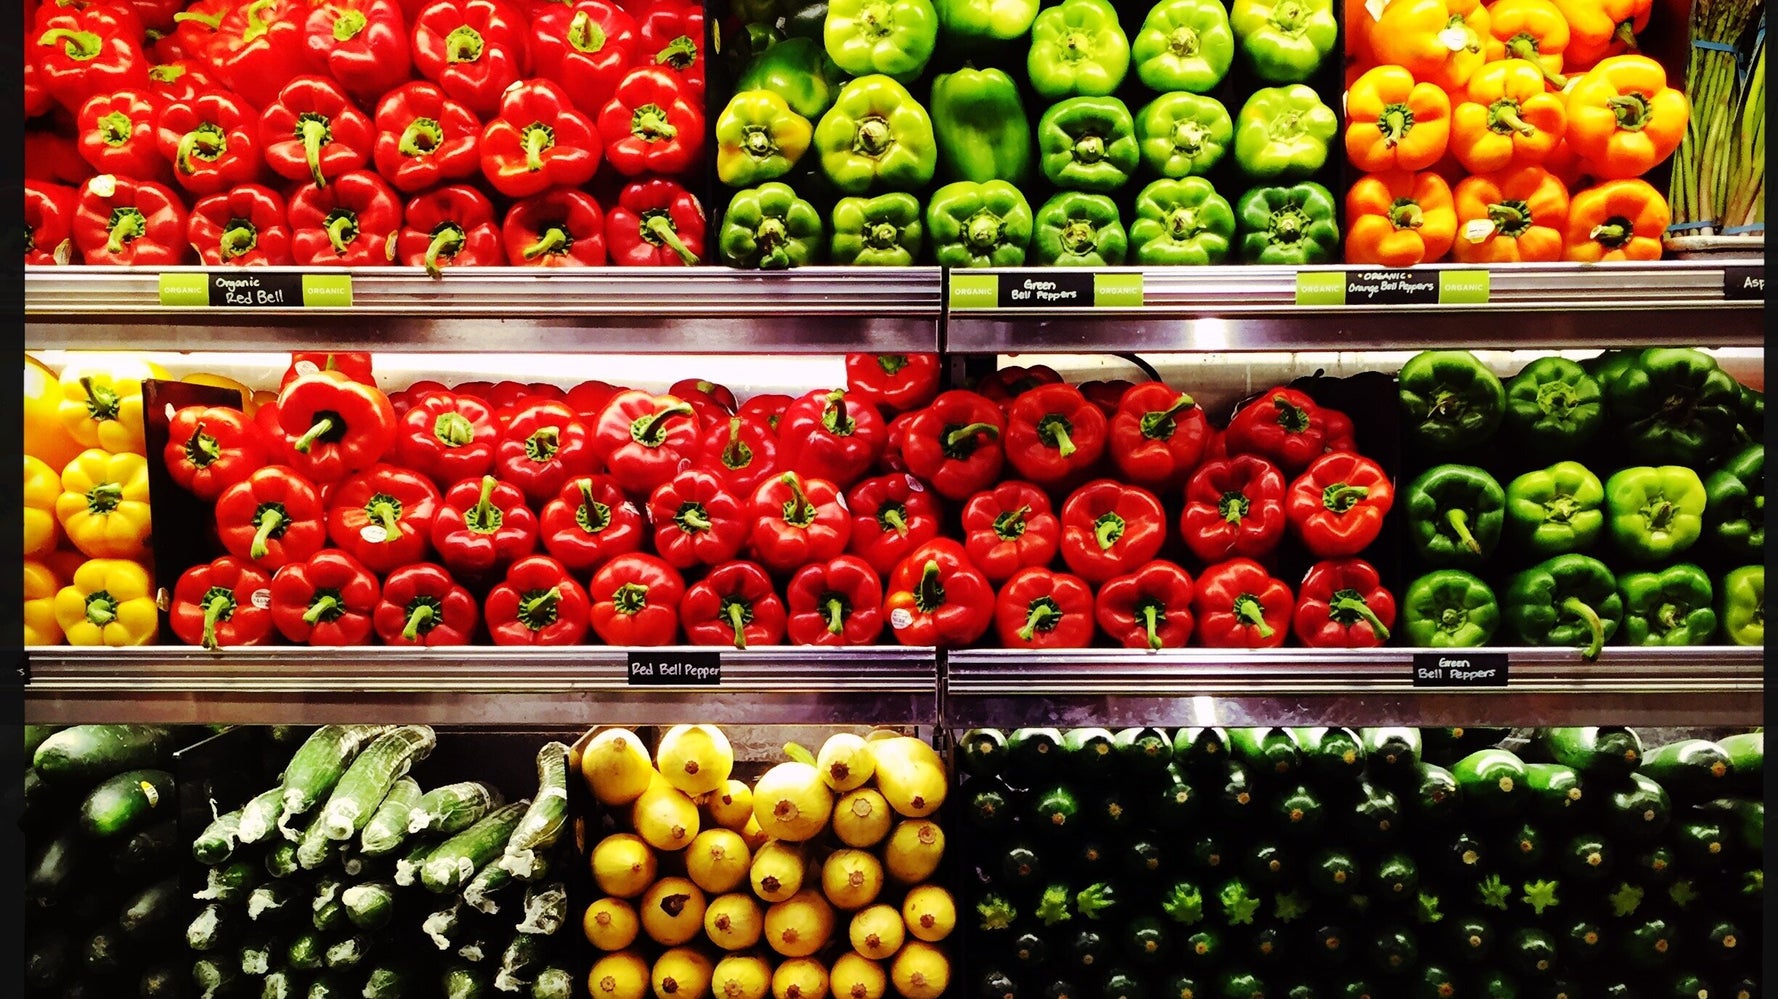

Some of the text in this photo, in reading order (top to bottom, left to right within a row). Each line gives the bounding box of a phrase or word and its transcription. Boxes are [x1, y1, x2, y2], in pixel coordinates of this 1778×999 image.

[1363, 272, 1407, 281] ORGANIC
[215, 276, 260, 292] Organic
[1023, 279, 1057, 291] Green
[1301, 285, 1340, 293] ORGANIC
[1444, 284, 1483, 292] ORGANIC
[164, 286, 202, 294] ORGANIC
[307, 287, 345, 295] ORGANIC
[1011, 289, 1077, 301] Bell Peppers
[1099, 287, 1137, 295] ORGANIC
[1348, 281, 1435, 299] Orange Bell Peppers
[225, 289, 284, 304] Red Bell
[1438, 657, 1471, 668] Green
[631, 662, 720, 680] Red Bell Pepper
[1417, 667, 1496, 681] Bell Peppers
